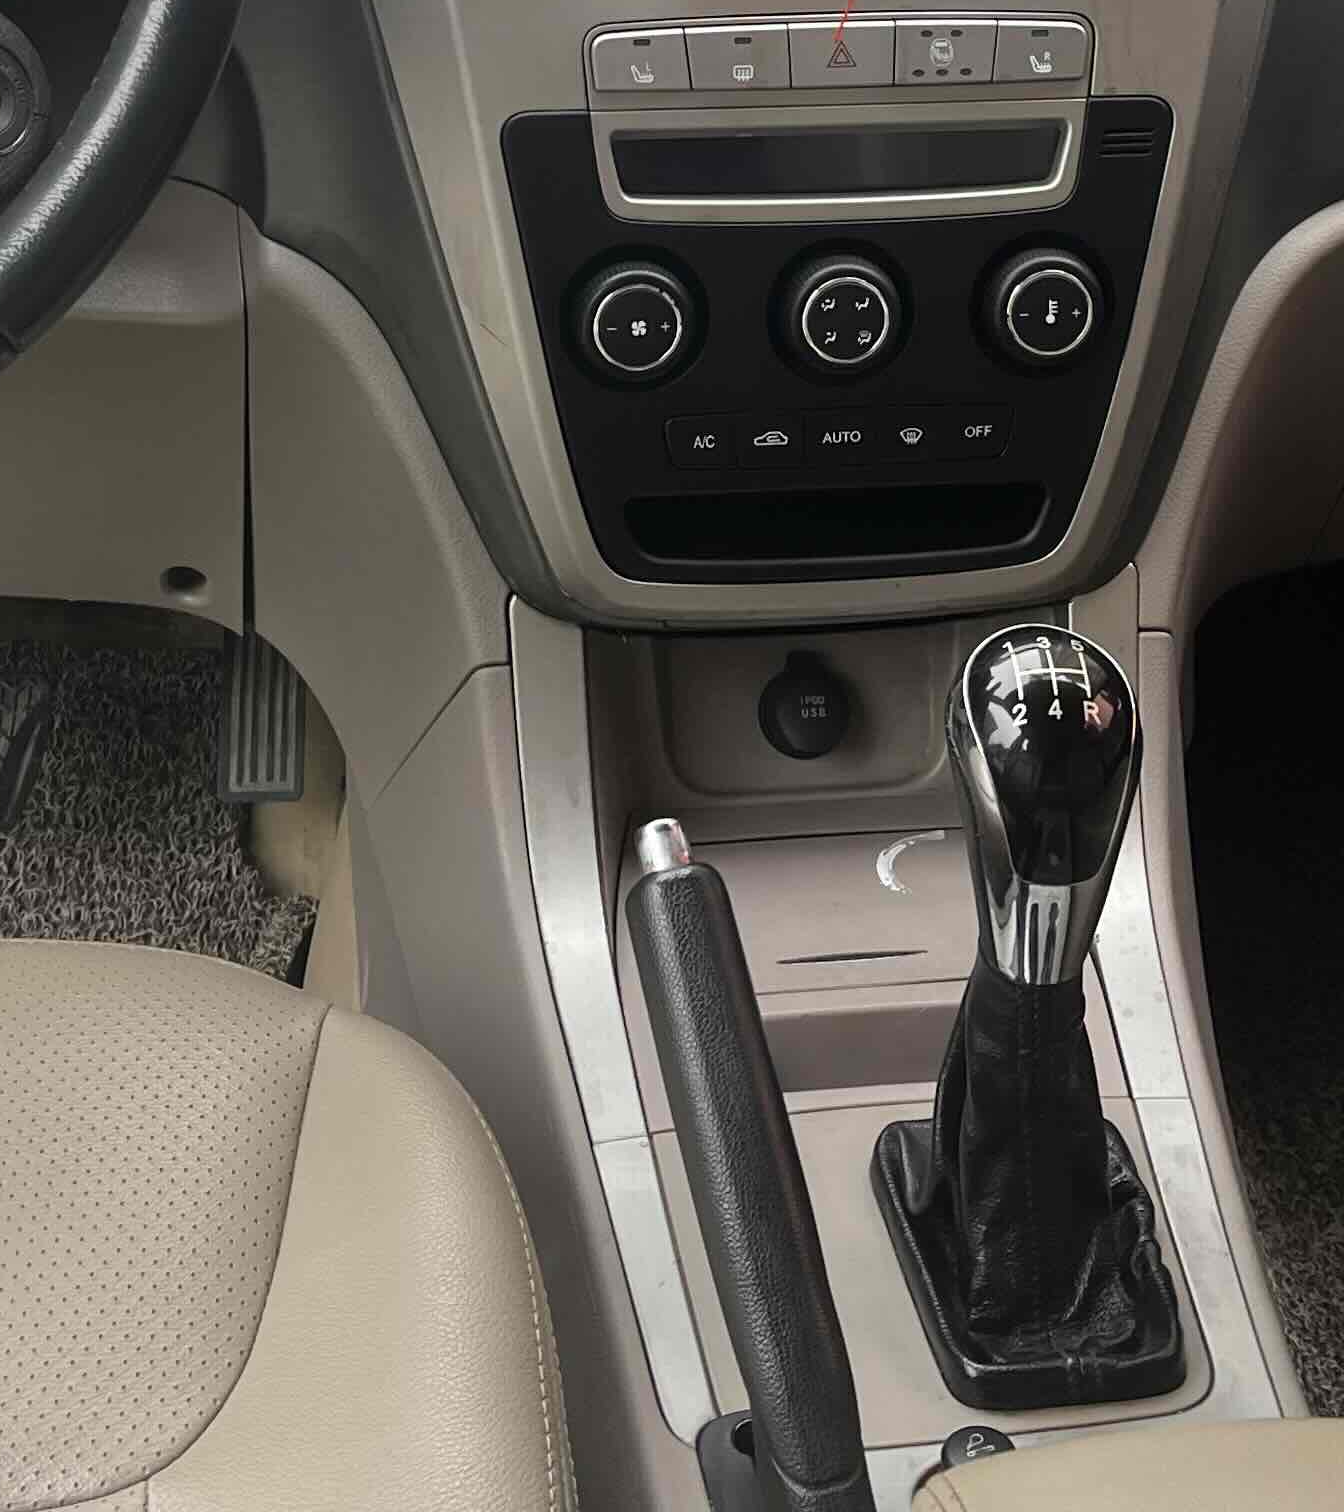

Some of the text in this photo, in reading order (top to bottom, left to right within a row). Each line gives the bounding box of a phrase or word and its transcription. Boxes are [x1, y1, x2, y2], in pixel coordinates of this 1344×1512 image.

[822, 430, 862, 445] AUTO
[964, 425, 993, 439] OFF
[693, 436, 716, 449] A/C
[1036, 636, 1052, 649] 3
[1070, 639, 1085, 652] 5
[801, 708, 827, 719] USB
[1011, 702, 1028, 728] 2
[1047, 698, 1064, 721] 4
[1082, 700, 1103, 727] R
